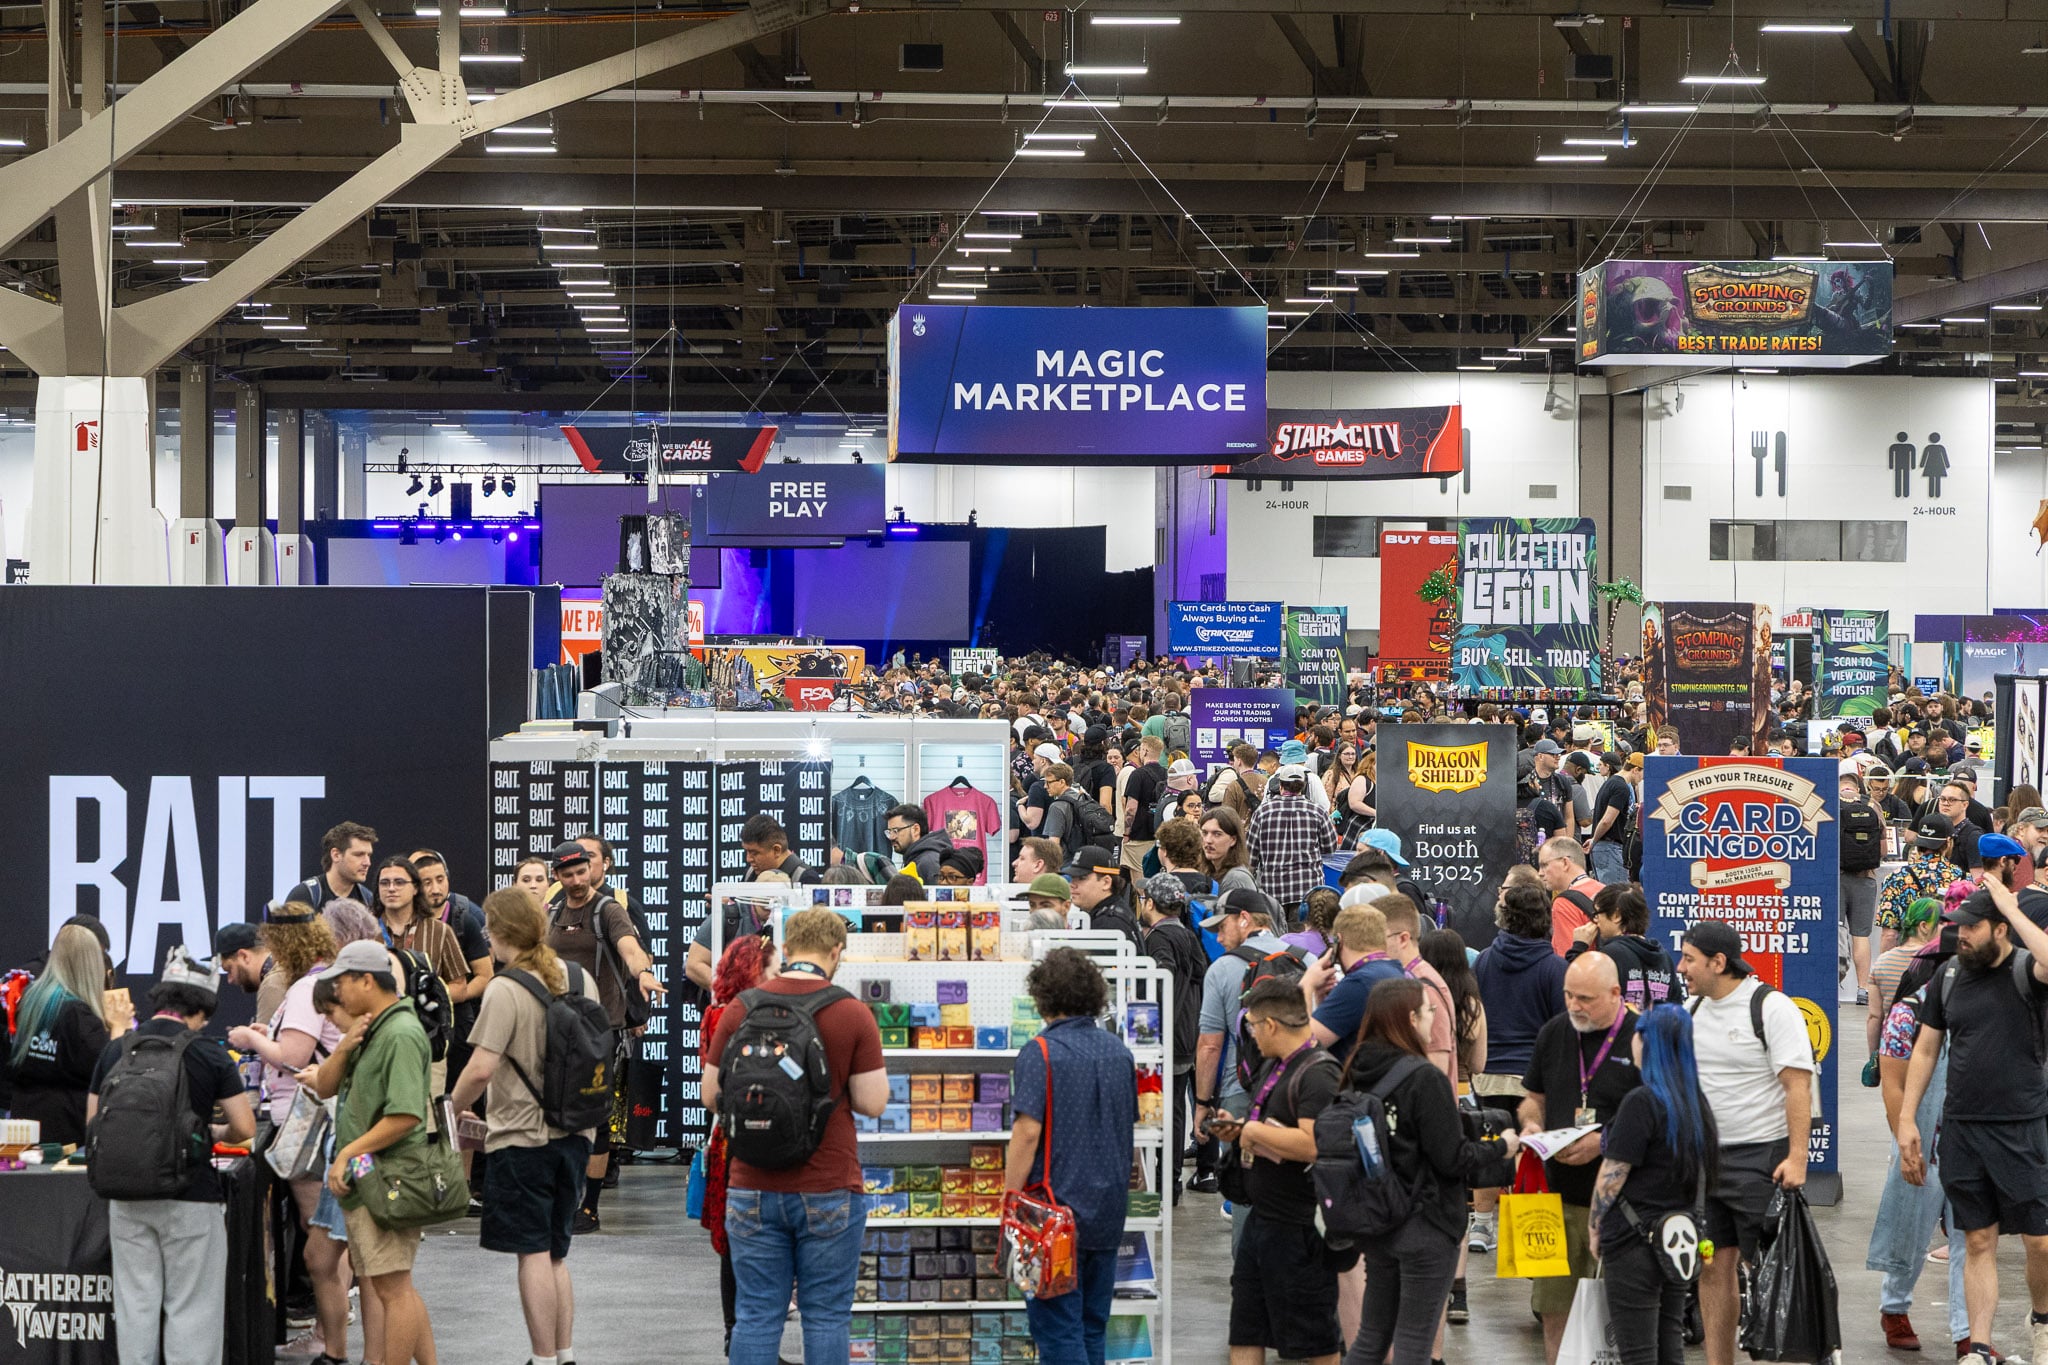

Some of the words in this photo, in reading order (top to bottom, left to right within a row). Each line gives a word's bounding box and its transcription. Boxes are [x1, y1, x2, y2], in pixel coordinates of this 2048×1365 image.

[1045, 13, 1058, 21] 623
[1695, 283, 1806, 304] STOMPING
[1714, 301, 1787, 313] GROUNDS
[1678, 335, 1716, 351] BEST
[1720, 336, 1768, 351] TRADE
[1771, 336, 1822, 351] RATES!
[1036, 350, 1164, 378] MAGIC
[190, 375, 201, 383] 11
[245, 399, 256, 407] 12
[953, 382, 1246, 412] MARKETPLACE
[688, 440, 712, 450] ALL
[1275, 423, 1332, 456] STAR
[1347, 423, 1401, 455] CITY
[662, 450, 712, 460] CARDS
[1316, 451, 1364, 462] GAMES
[770, 482, 826, 498] FREE
[769, 502, 827, 518] PLAY
[1266, 500, 1309, 510] 24-HOUR
[1913, 507, 1956, 516] 24-HOUR
[1385, 535, 1422, 545] BUY
[1428, 535, 1459, 545] SEL
[1464, 534, 1587, 570] COLLECTOR
[1177, 604, 1198, 612] Turn
[1200, 604, 1226, 612] Cards
[1228, 604, 1247, 612] Into
[1248, 604, 1271, 612] Cash
[587, 610, 602, 632] PA
[1182, 615, 1214, 624] Always
[1216, 615, 1247, 624] Buying
[1249, 615, 1266, 623] at...
[1299, 614, 1340, 623] COLLECTOR
[1782, 614, 1803, 627] PAPA
[1830, 617, 1876, 628] COLLECTOR
[1200, 629, 1255, 639] STRIKEZONE
[1676, 631, 1742, 650] STOMPING
[951, 649, 997, 660] COLLECTOR
[1172, 645, 1278, 653] WWW.STRIKEZONEONLINE.COM
[1301, 648, 1321, 658] SCAN
[1325, 648, 1337, 658] TO
[1461, 648, 1491, 666] BUY
[1503, 648, 1533, 667] SELL
[1546, 649, 1590, 668] TRADE
[1687, 649, 1731, 660] GROUNDS
[1973, 648, 2008, 656] MAGIC
[1298, 662, 1320, 672] VIEW
[1321, 662, 1340, 672] OUR
[1833, 656, 1858, 667] SCAN
[1859, 656, 1873, 667] TO
[1299, 675, 1338, 685] HOTLIST!
[1400, 667, 1449, 678] EXPE
[1830, 670, 1854, 681] VIEW
[1855, 671, 1876, 682] OUR
[800, 687, 834, 700] PSA
[1670, 683, 1748, 693] STOMPINGGROUNDSTCG.COM
[1832, 685, 1874, 696] HOTLIST!
[1414, 750, 1480, 769] DRAGON
[495, 770, 521, 789] BAIT.
[564, 770, 590, 789] BAIT.
[603, 771, 630, 789] BAIT.
[683, 771, 709, 789] BAIT.
[720, 772, 746, 791] BAIT.
[800, 771, 825, 789] BAIT.
[1421, 769, 1475, 783] SHIELD
[1688, 776, 1713, 790] FIND
[1713, 772, 1741, 783] YOUR
[1743, 771, 1795, 792] TREASURE
[530, 783, 556, 801] BAIT.
[643, 783, 669, 801] BAIT.
[760, 783, 786, 802] BAIT.
[495, 796, 521, 815] BAIT.
[564, 796, 590, 815] BAIT.
[603, 797, 630, 815] BAIT.
[683, 797, 709, 815] BAIT.
[720, 797, 746, 817] BAIT.
[800, 797, 825, 815] BAIT.
[530, 809, 556, 827] BAIT.
[643, 809, 669, 827] BAIT.
[1679, 801, 1804, 834] CARD
[495, 822, 521, 841] BAIT.
[603, 823, 630, 841] BAIT.
[683, 823, 709, 841] BAIT.
[800, 823, 825, 841] BAIT.
[1419, 824, 1444, 835] Find
[1447, 826, 1461, 835] us
[1464, 824, 1477, 835] at
[643, 835, 669, 853] BAIT.
[1415, 840, 1479, 859] Booth
[1666, 833, 1816, 860] KINGDOM
[612, 848, 630, 867] AIT.
[683, 848, 709, 867] BAIT.
[720, 849, 746, 869] BAIT.
[49, 775, 326, 975] BAIT
[643, 861, 669, 879] BAIT.
[1410, 864, 1484, 886] #13025
[1714, 877, 1733, 885] MAGIC
[1734, 869, 1774, 880] MARKETPLACE
[1725, 870, 1745, 878] BOOTH
[683, 874, 709, 892] BAIT.
[643, 887, 669, 905] BAIT.
[1658, 893, 1733, 906] COMPLETE
[1736, 894, 1789, 907] QUESTS
[1793, 896, 1821, 908] FOR
[1657, 906, 1685, 918] THE
[1688, 906, 1757, 919] KINGDOM
[1761, 908, 1780, 920] TO
[1784, 909, 1822, 921] EARN
[1727, 920, 1773, 933] SHARE
[1776, 921, 1796, 933] OF
[651, 938, 669, 957] AIT.
[1669, 930, 1809, 954] TSURE!
[683, 1030, 700, 1049] BAI
[1809, 1138, 1830, 1150] IVE
[1525, 1232, 1555, 1246] TWG
[4, 1302, 106, 1348] TAVERN
